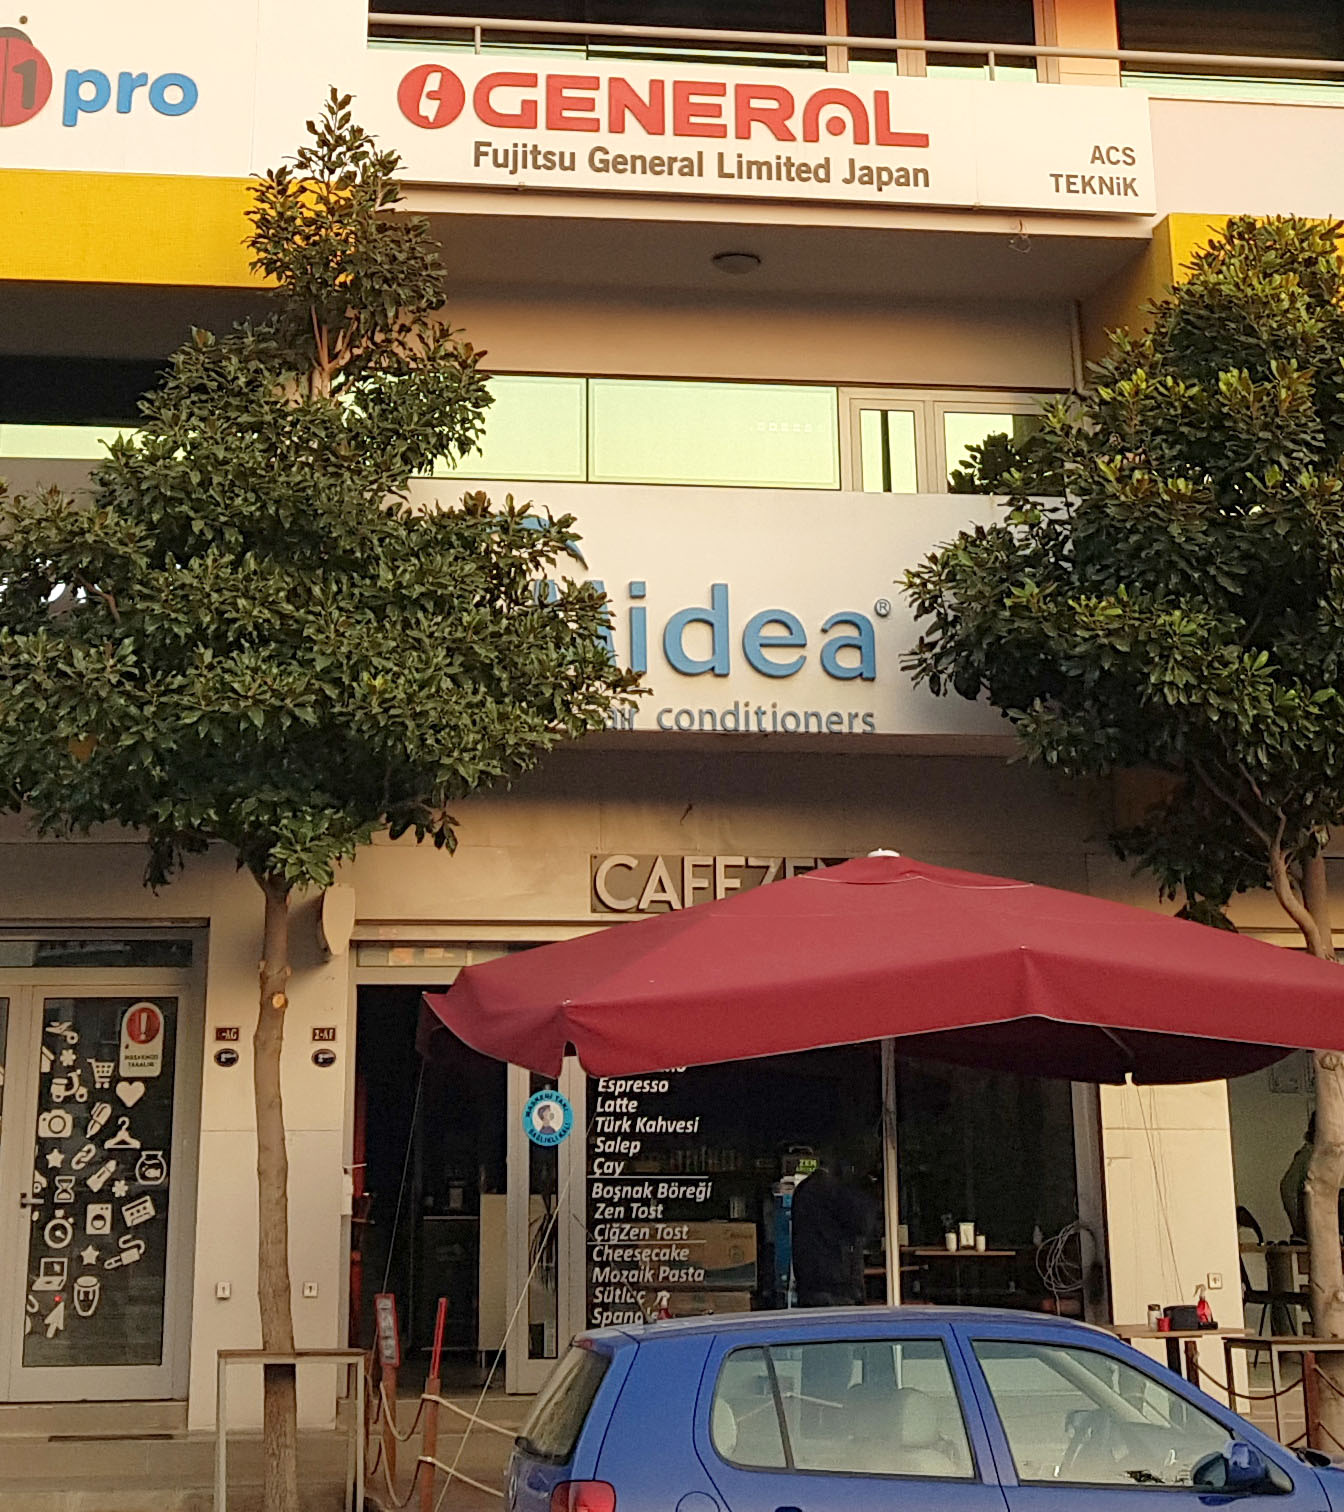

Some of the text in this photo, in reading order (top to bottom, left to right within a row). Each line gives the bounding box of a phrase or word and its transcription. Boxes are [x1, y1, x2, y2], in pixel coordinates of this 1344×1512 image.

[472, 71, 930, 149] GENERAL
[1089, 144, 1137, 167] ACS
[473, 140, 930, 192] Fujitsu General Limited Japan
[657, 701, 876, 734] conditioners
[597, 1077, 670, 1096] Espresso
[596, 1096, 638, 1113] Latte
[595, 1116, 700, 1133] Türk Kahvesi
[594, 1136, 641, 1157] Salep
[593, 1157, 625, 1177] Çay
[592, 1181, 713, 1202] Boşnak Böreği
[594, 1202, 664, 1219] Zen Tost
[655, 1224, 690, 1240] Tost
[592, 1244, 690, 1261] Cheesecake
[592, 1265, 705, 1283] Mozaik Pasta
